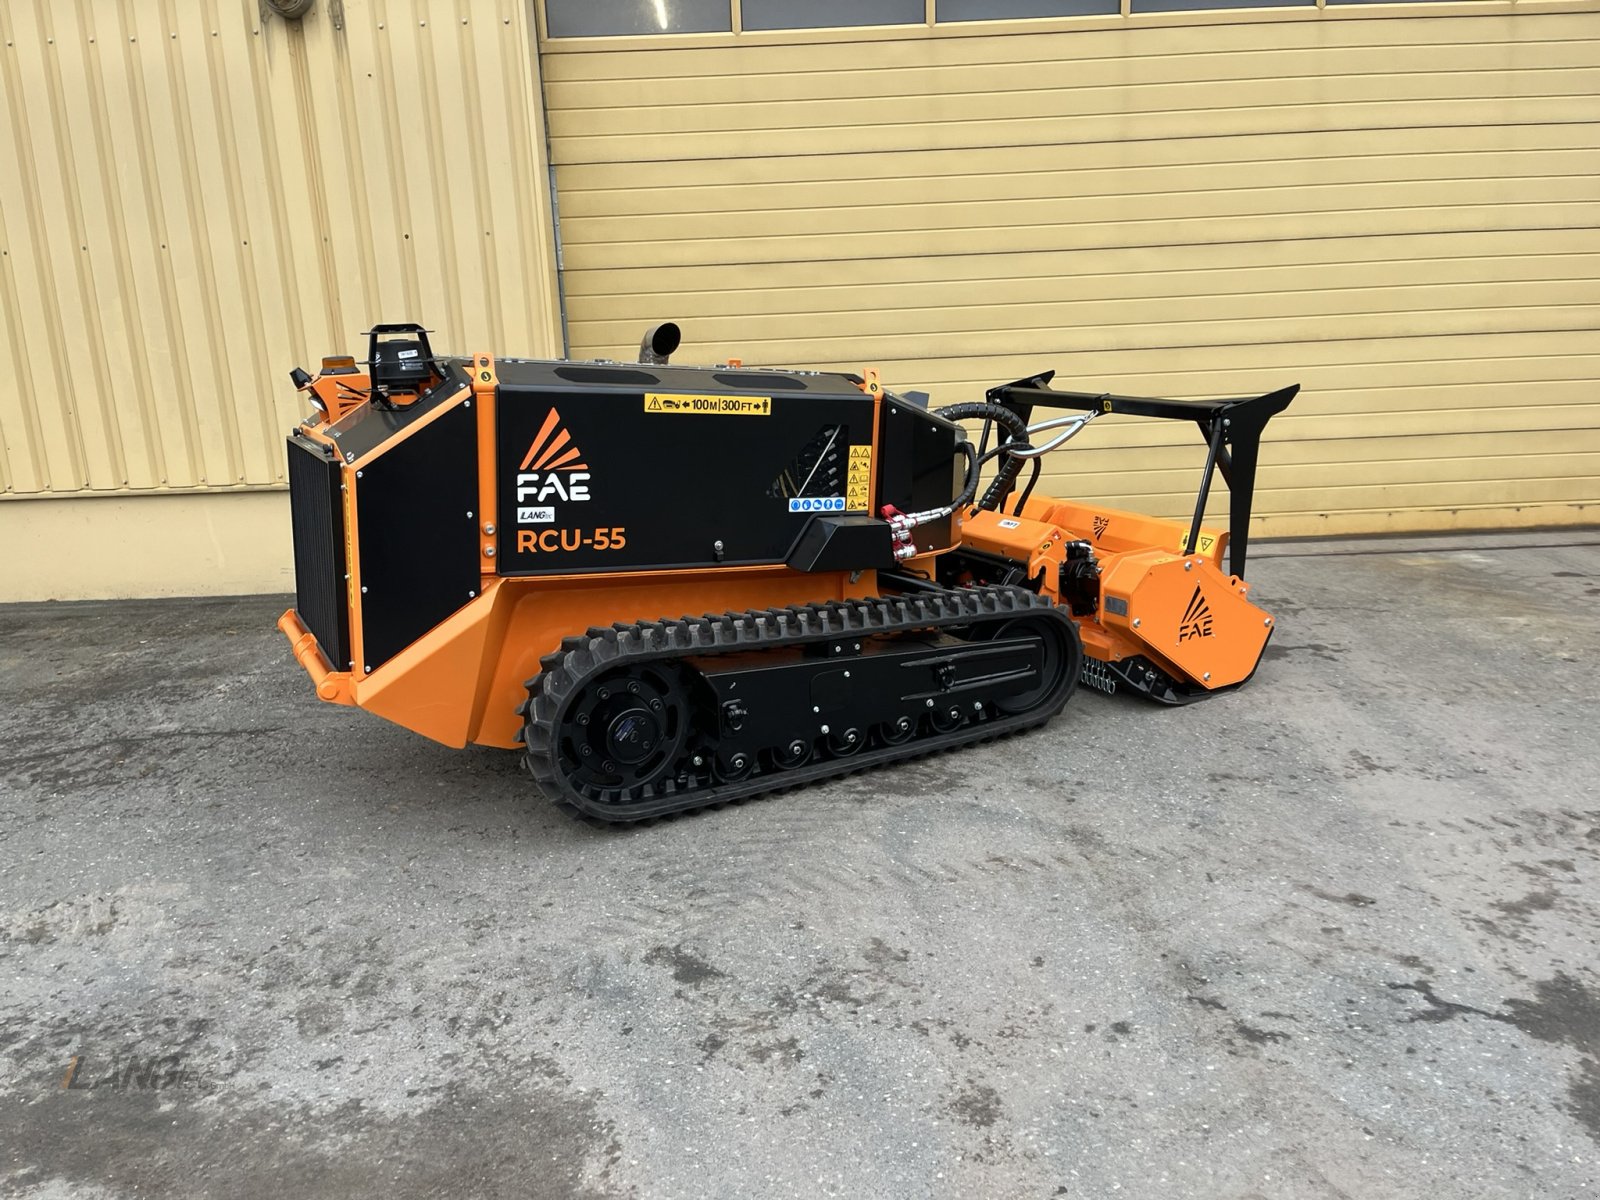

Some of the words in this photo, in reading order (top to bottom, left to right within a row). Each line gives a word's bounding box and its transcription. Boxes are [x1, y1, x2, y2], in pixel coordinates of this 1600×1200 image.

[517, 473, 590, 502] FAE
[517, 527, 626, 553] RCU-55
[1179, 620, 1213, 642] FAE
